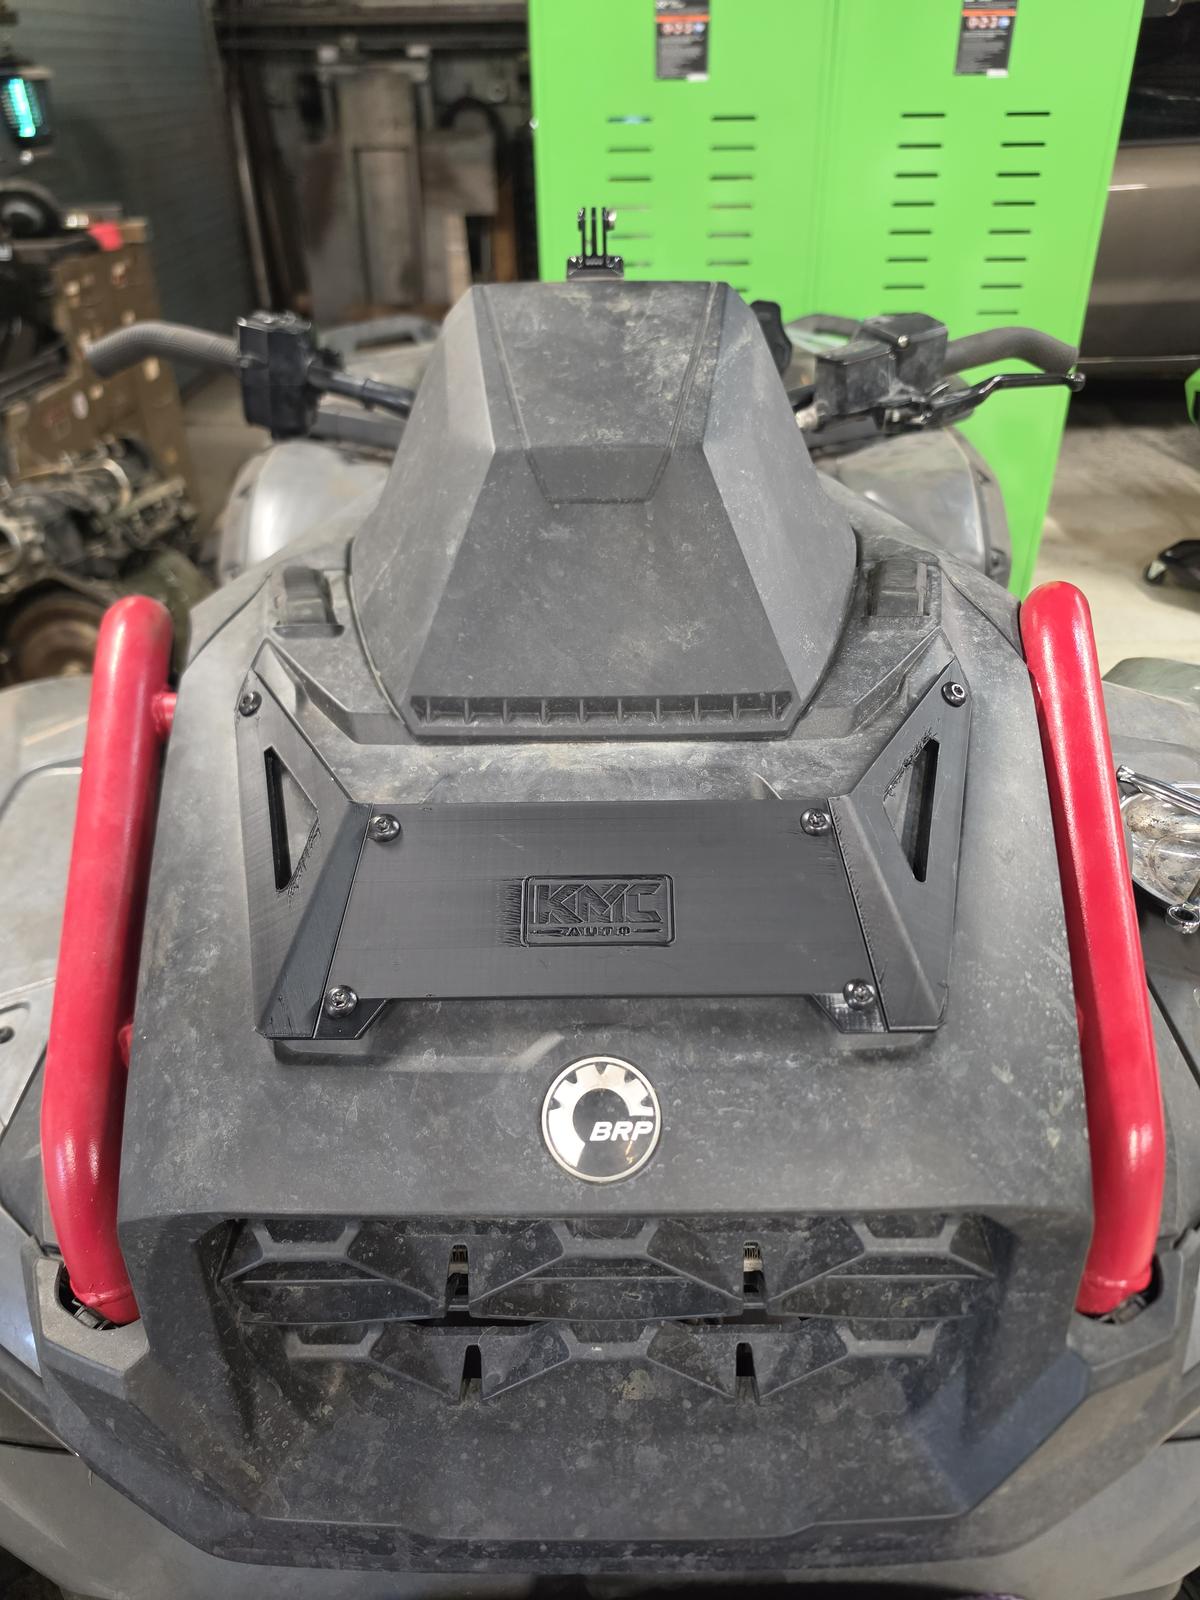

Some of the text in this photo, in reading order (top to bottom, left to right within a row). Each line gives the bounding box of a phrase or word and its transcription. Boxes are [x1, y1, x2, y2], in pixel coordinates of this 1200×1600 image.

[533, 884, 663, 924] KMC
[567, 926, 631, 937] AUTO
[589, 1120, 654, 1141] BRP
